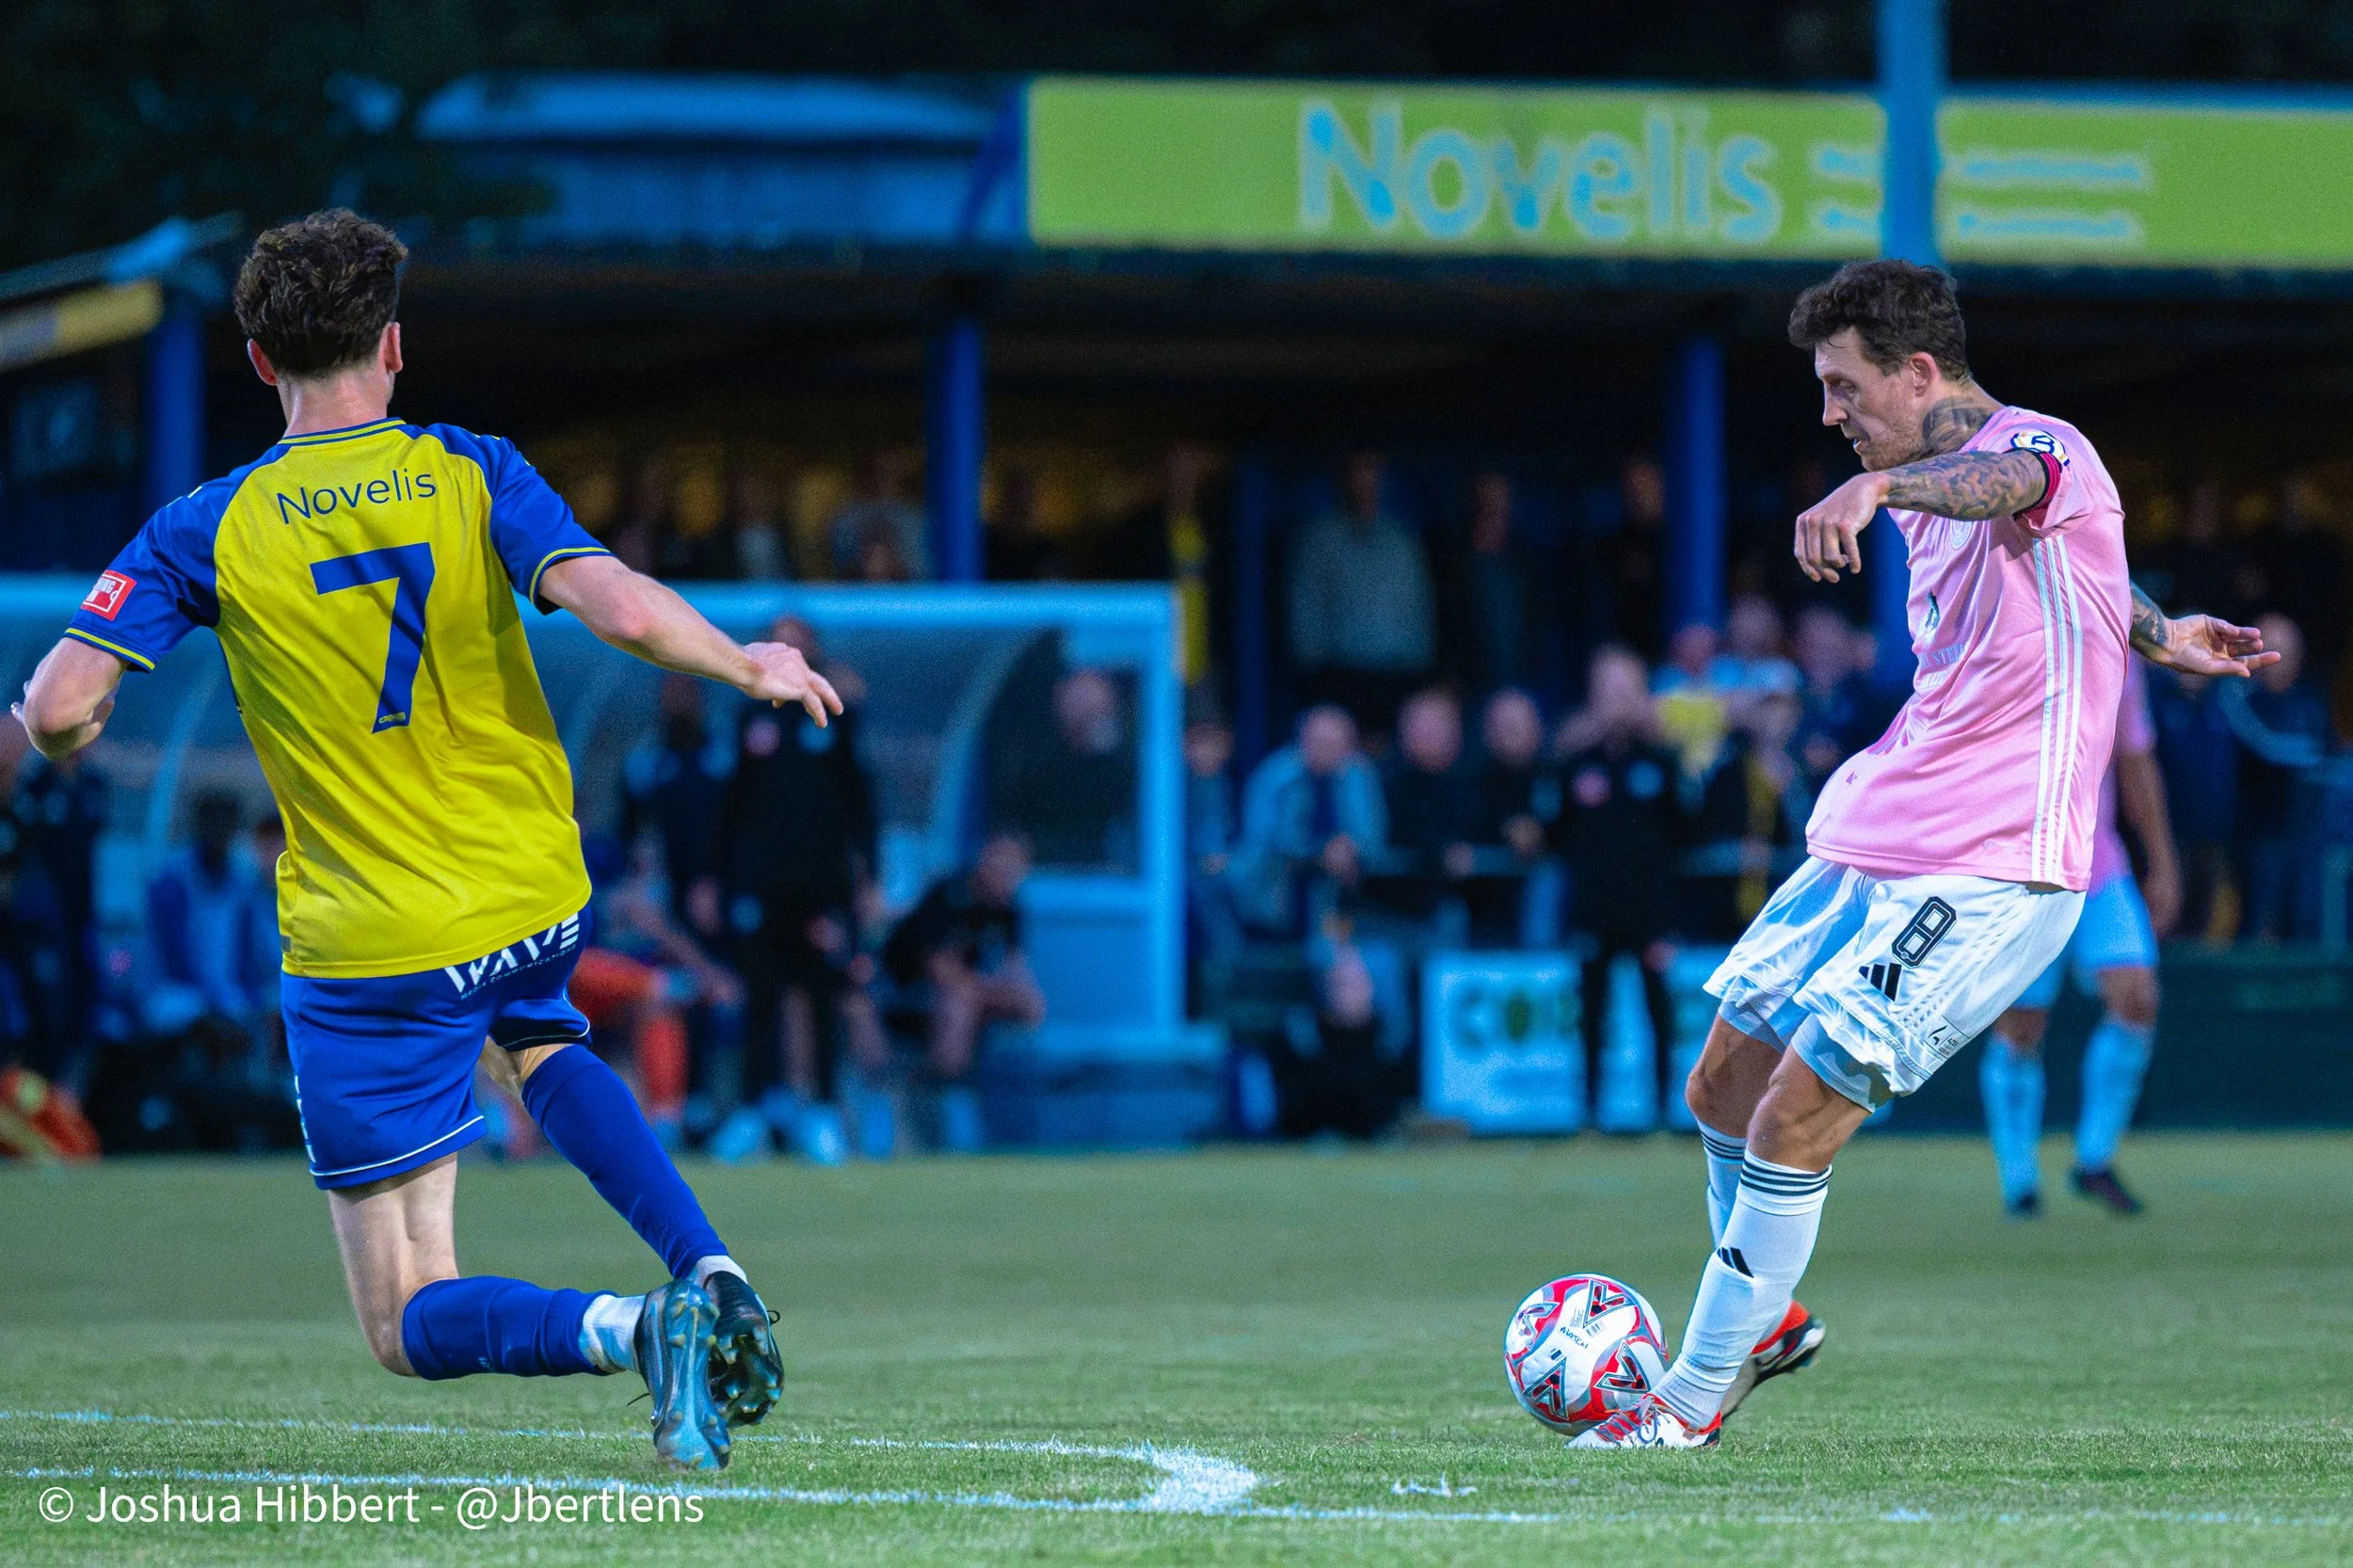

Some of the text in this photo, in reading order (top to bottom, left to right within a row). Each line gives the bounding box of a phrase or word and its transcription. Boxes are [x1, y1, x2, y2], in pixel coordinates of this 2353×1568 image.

[1301, 102, 1781, 243] Novelis
[276, 468, 437, 524] Novelis
[309, 541, 436, 734] 7
[1892, 896, 1957, 968] 8
